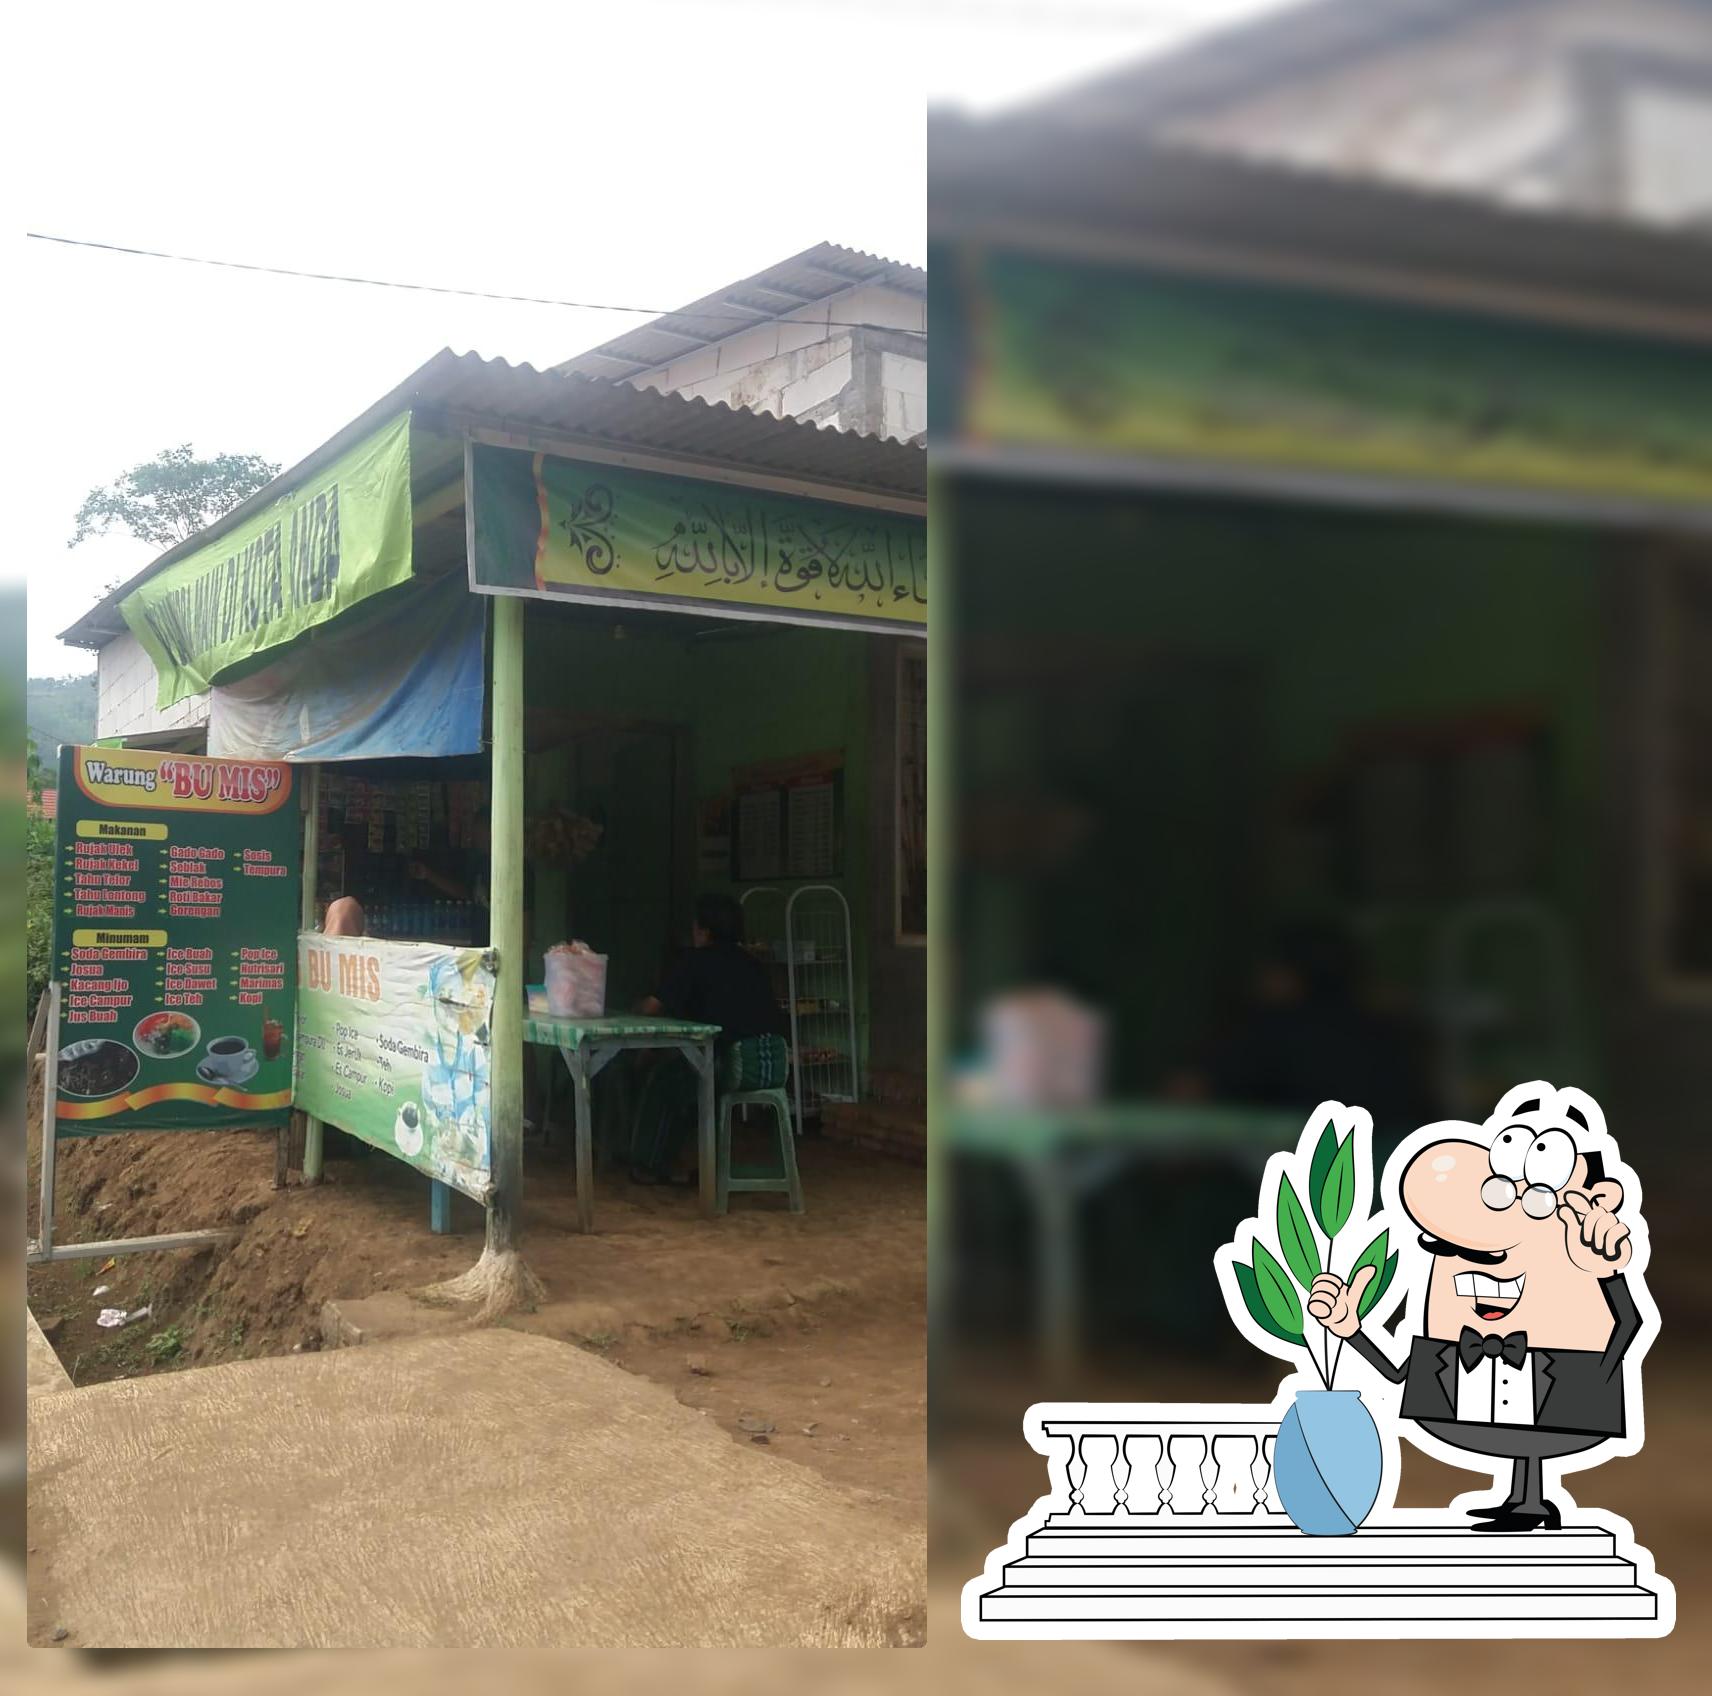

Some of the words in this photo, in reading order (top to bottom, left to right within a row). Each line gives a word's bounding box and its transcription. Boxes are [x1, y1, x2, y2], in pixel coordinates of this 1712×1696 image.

[86, 761, 157, 791] Warung
[99, 823, 147, 837] Makanan
[169, 846, 198, 859] Gado
[198, 847, 226, 860] Gado
[169, 860, 206, 874] Seblak
[243, 863, 287, 877] Tempura
[71, 947, 100, 961] Soda
[101, 947, 149, 961] Gembira
[167, 948, 185, 960] Ice
[185, 948, 213, 961] Buah
[70, 962, 104, 976] Josua
[166, 963, 184, 975] Ice
[308, 948, 332, 993] BU
[339, 952, 380, 1003] MIS
[69, 978, 112, 992] Kacang
[165, 977, 183, 990] Ice
[68, 994, 89, 1008] Ice
[89, 994, 134, 1008] Campur
[165, 992, 183, 1006] Ice
[183, 992, 204, 1006] Teh
[238, 991, 264, 1004] Kopi
[67, 1009, 87, 1023] Jus
[88, 1009, 119, 1023] Buah
[378, 1033, 397, 1054] Soda
[396, 1040, 430, 1064] Gembira
